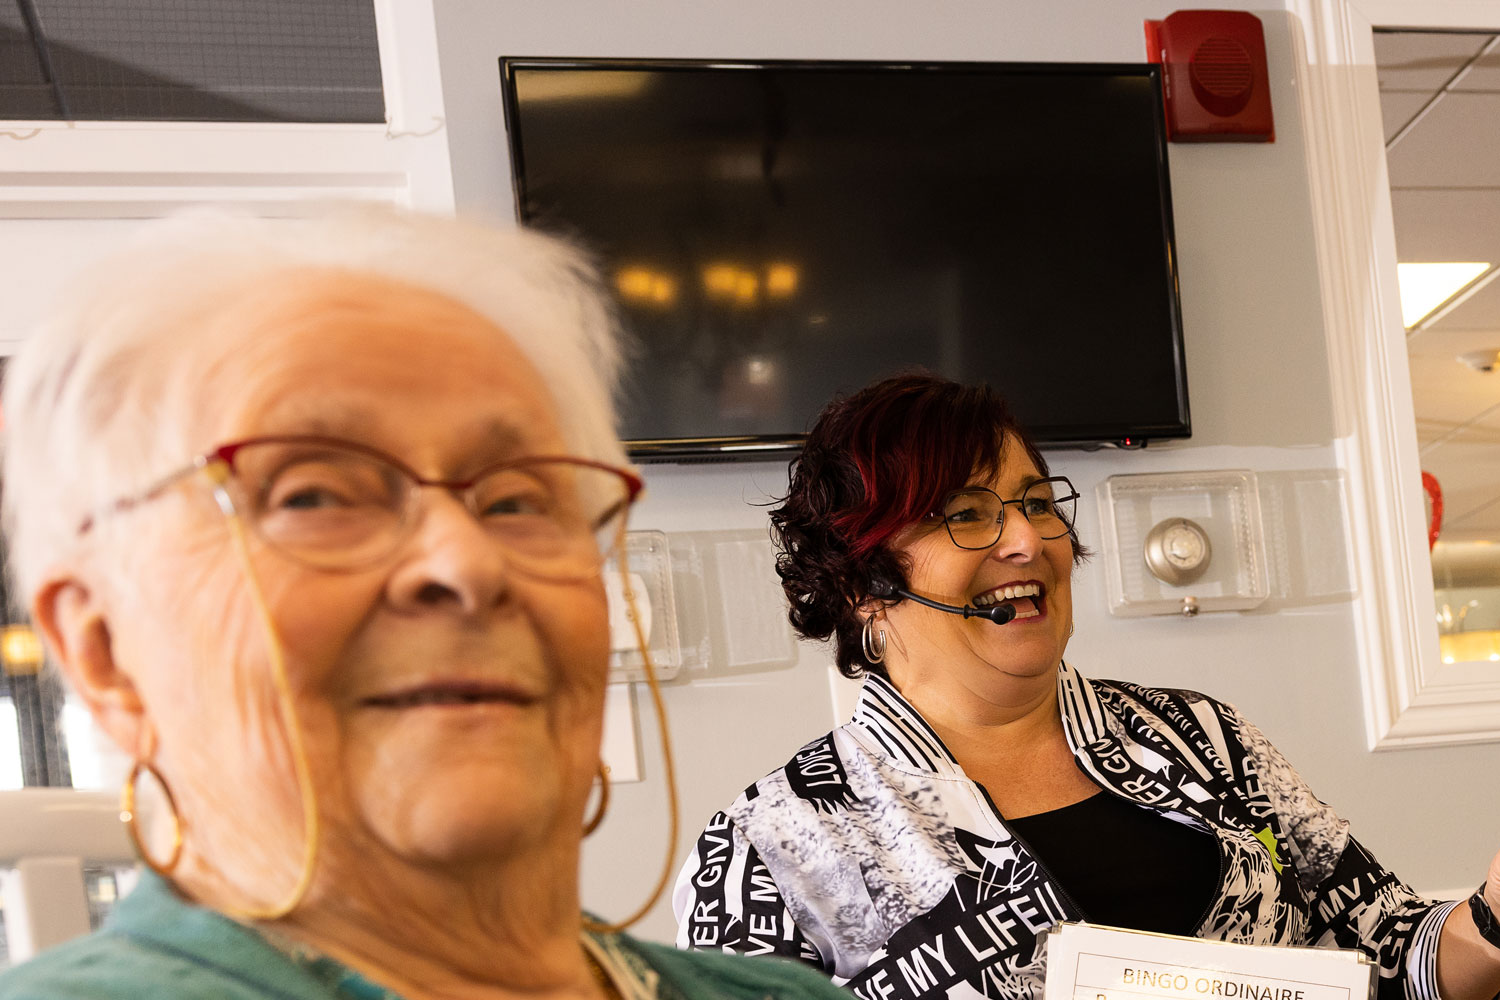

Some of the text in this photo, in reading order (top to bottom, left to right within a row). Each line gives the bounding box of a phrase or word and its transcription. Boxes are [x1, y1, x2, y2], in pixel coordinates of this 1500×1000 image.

[696, 814, 731, 888] GIVE
[896, 933, 956, 998] MY
[1122, 967, 1189, 992] BINGO
